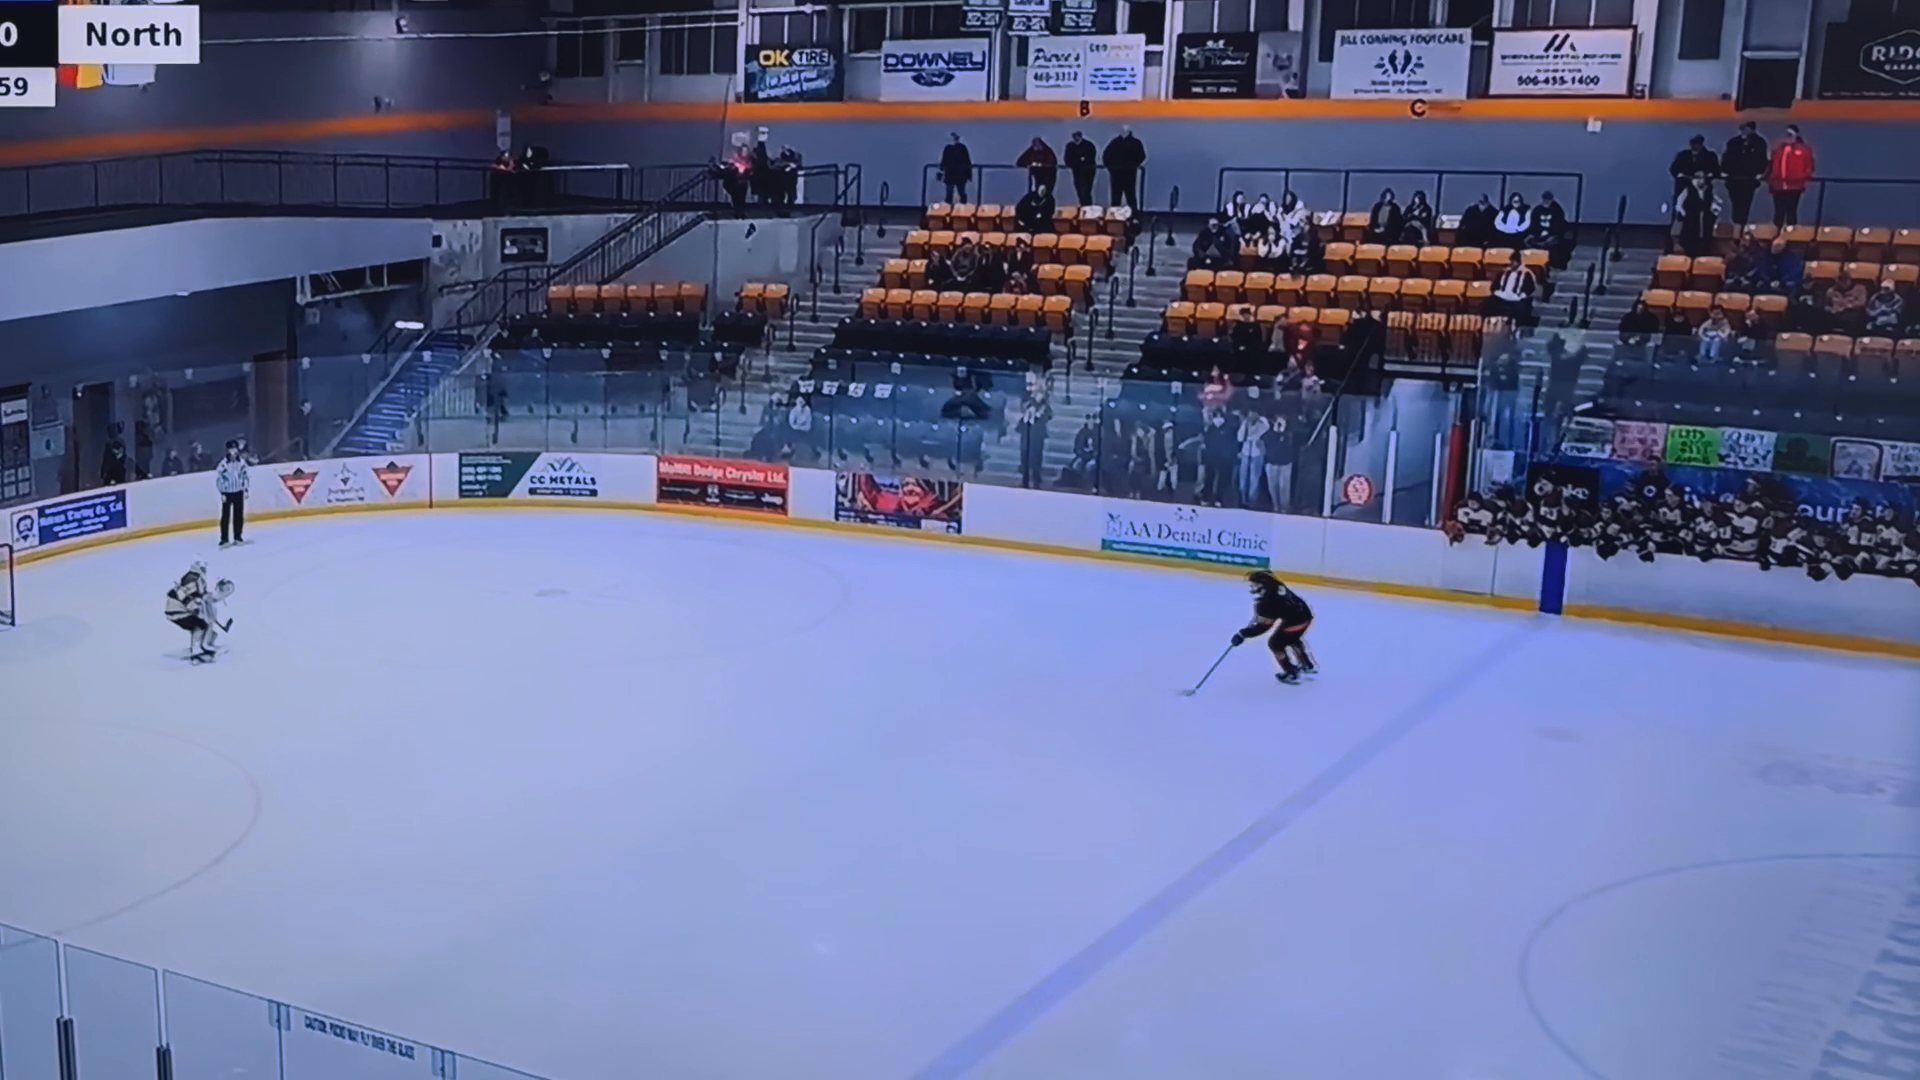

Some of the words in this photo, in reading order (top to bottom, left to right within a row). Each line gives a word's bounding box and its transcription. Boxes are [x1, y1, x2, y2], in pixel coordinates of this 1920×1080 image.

[759, 50, 789, 66] OK
[798, 50, 829, 64] TIRE
[883, 51, 986, 71] DOWNEY
[1080, 100, 1090, 116] B
[1410, 98, 1428, 117] C
[694, 464, 724, 480] Dodge
[530, 475, 546, 484] CC
[549, 475, 597, 486] METALS
[1124, 521, 1151, 538] AA
[1157, 523, 1212, 545] Dental
[1217, 529, 1268, 551] Clinic
